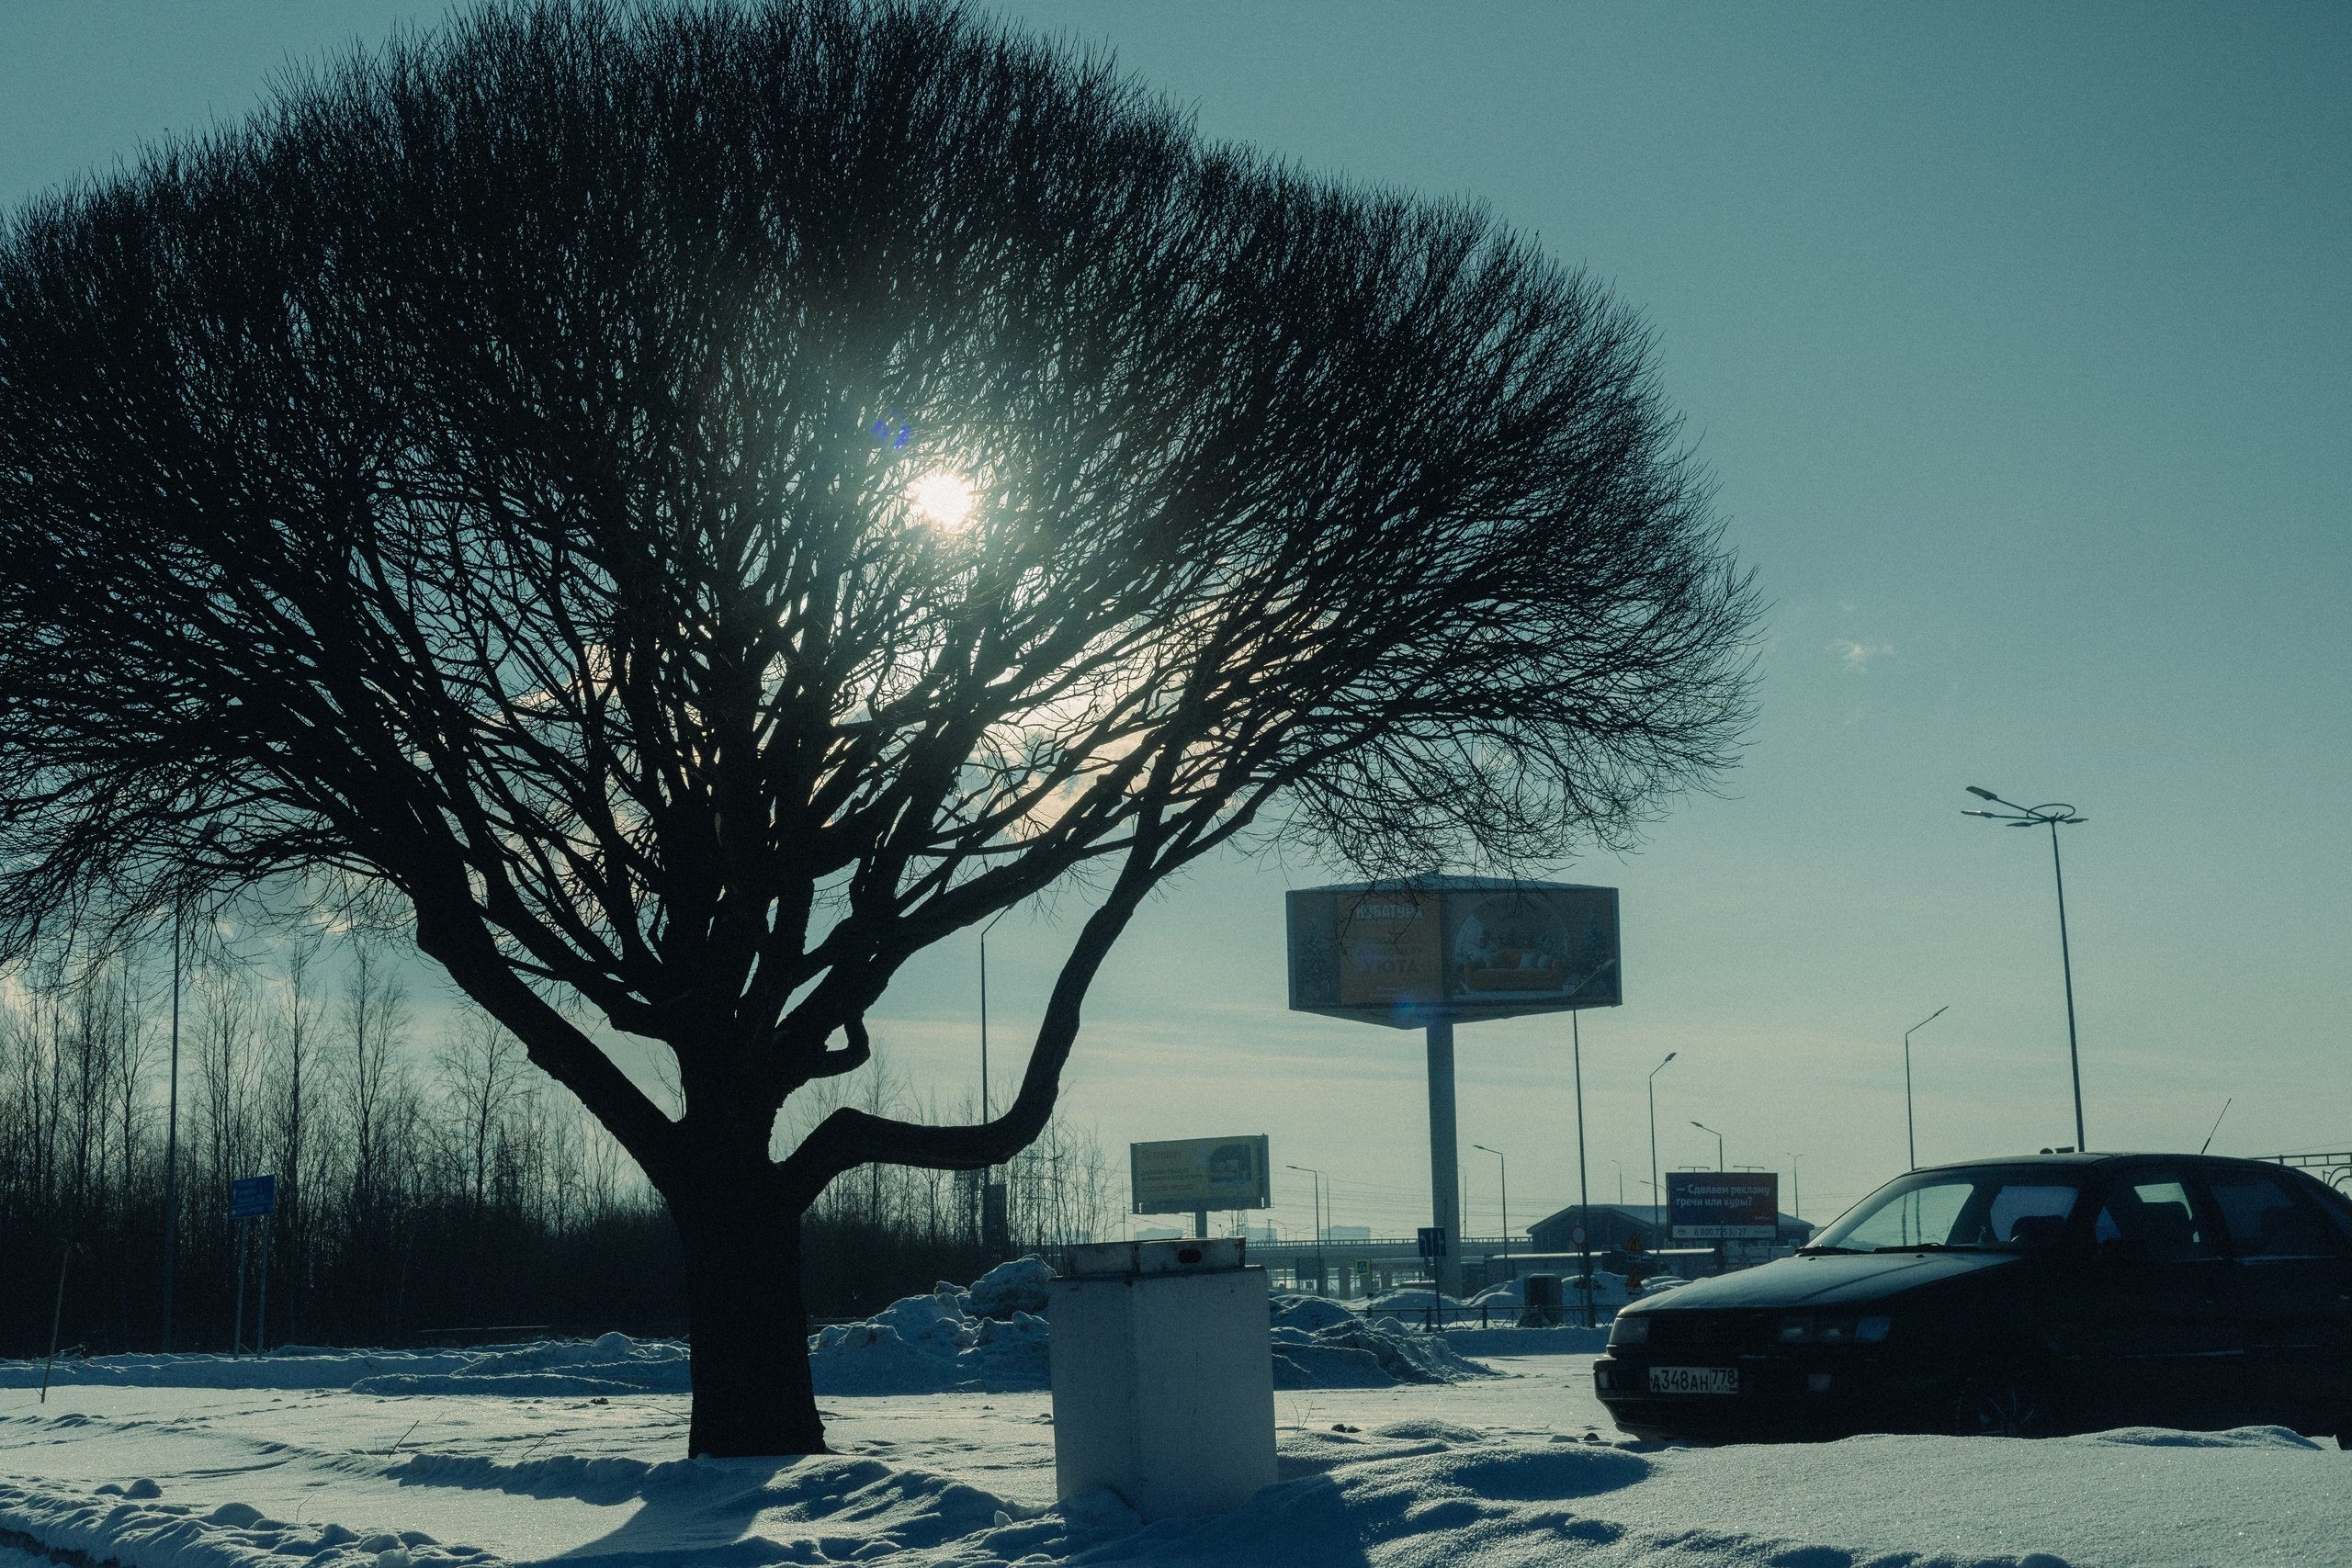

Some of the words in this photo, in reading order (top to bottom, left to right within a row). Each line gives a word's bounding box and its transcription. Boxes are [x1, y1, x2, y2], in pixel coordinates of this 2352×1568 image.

[1355, 904, 1422, 919] КУБАТУРА
[1688, 1184, 1728, 1195] Сделаем
[1730, 1185, 1770, 1196] рекламу
[1676, 1198, 1702, 1208] гречи
[1704, 1198, 1723, 1206] или
[1724, 1197, 1753, 1208] куры?
[1694, 1228, 1699, 1236] 8
[1700, 1228, 1713, 1236] 800
[1715, 1228, 1727, 1236] 75
[1711, 1369, 1736, 1385] 778
